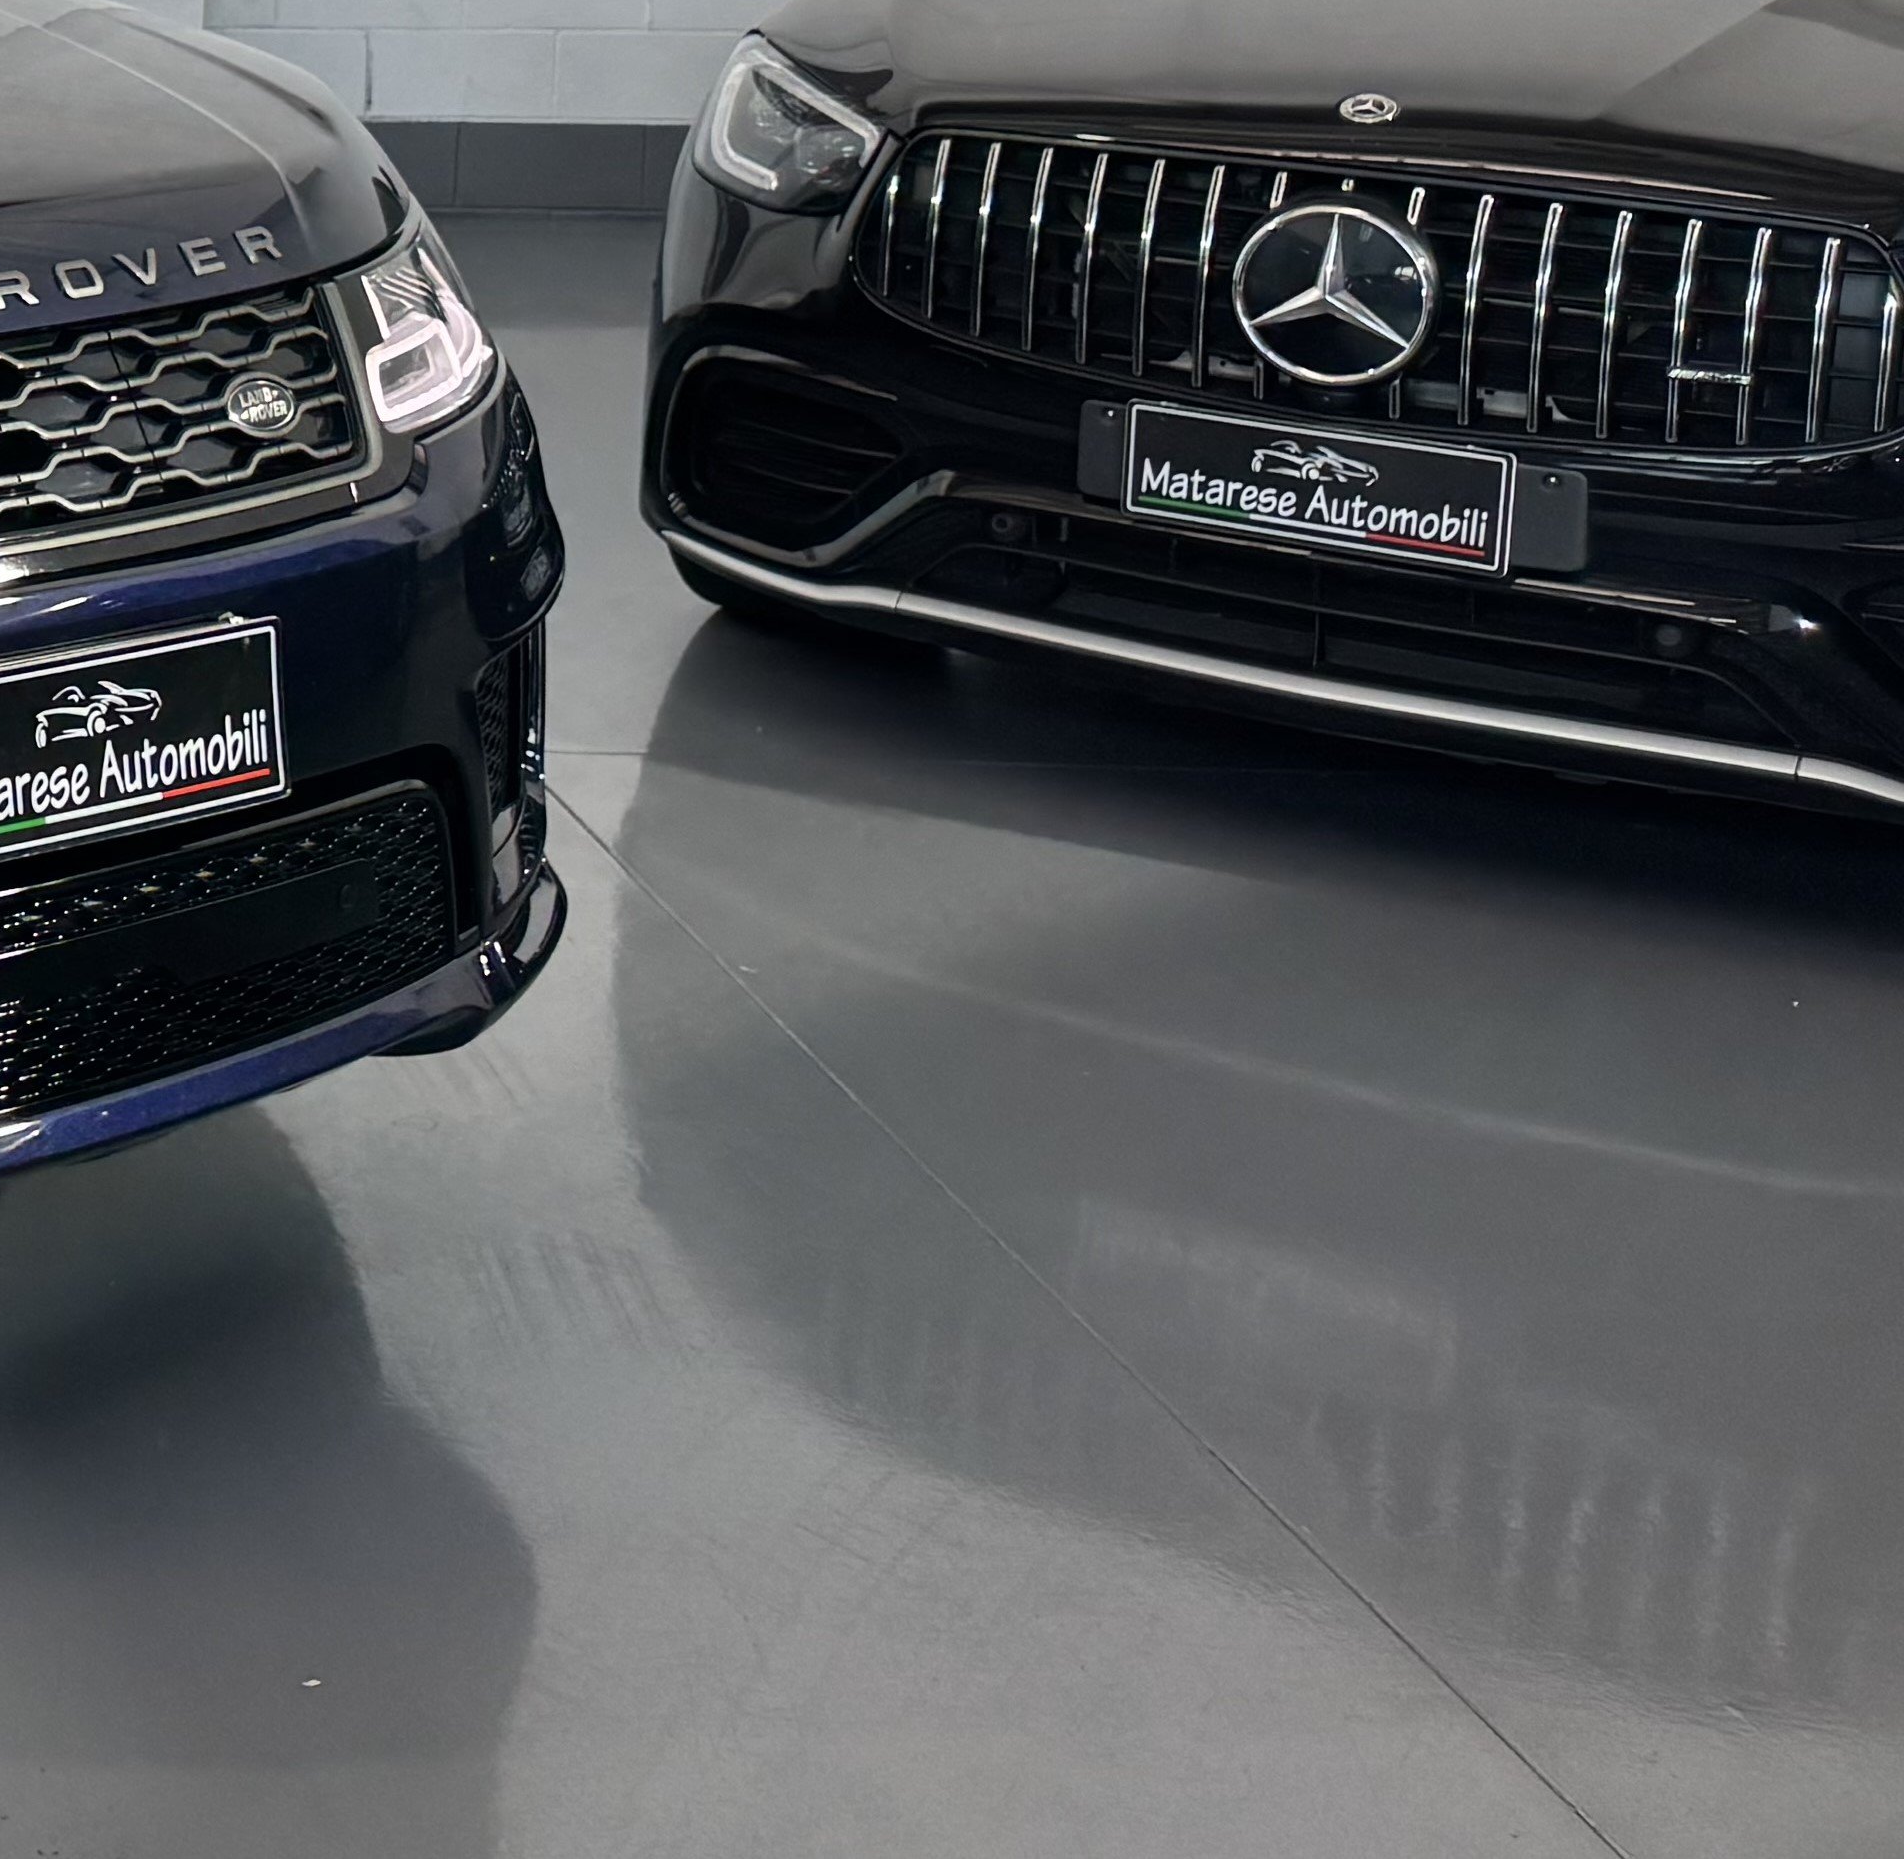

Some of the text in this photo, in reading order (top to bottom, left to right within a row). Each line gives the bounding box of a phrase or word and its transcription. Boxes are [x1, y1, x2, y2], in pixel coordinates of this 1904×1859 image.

[238, 387, 272, 408] LAND
[248, 400, 288, 422] ROVER
[1140, 457, 1489, 549] Matarese Automobili
[99, 708, 268, 799] Automobili
